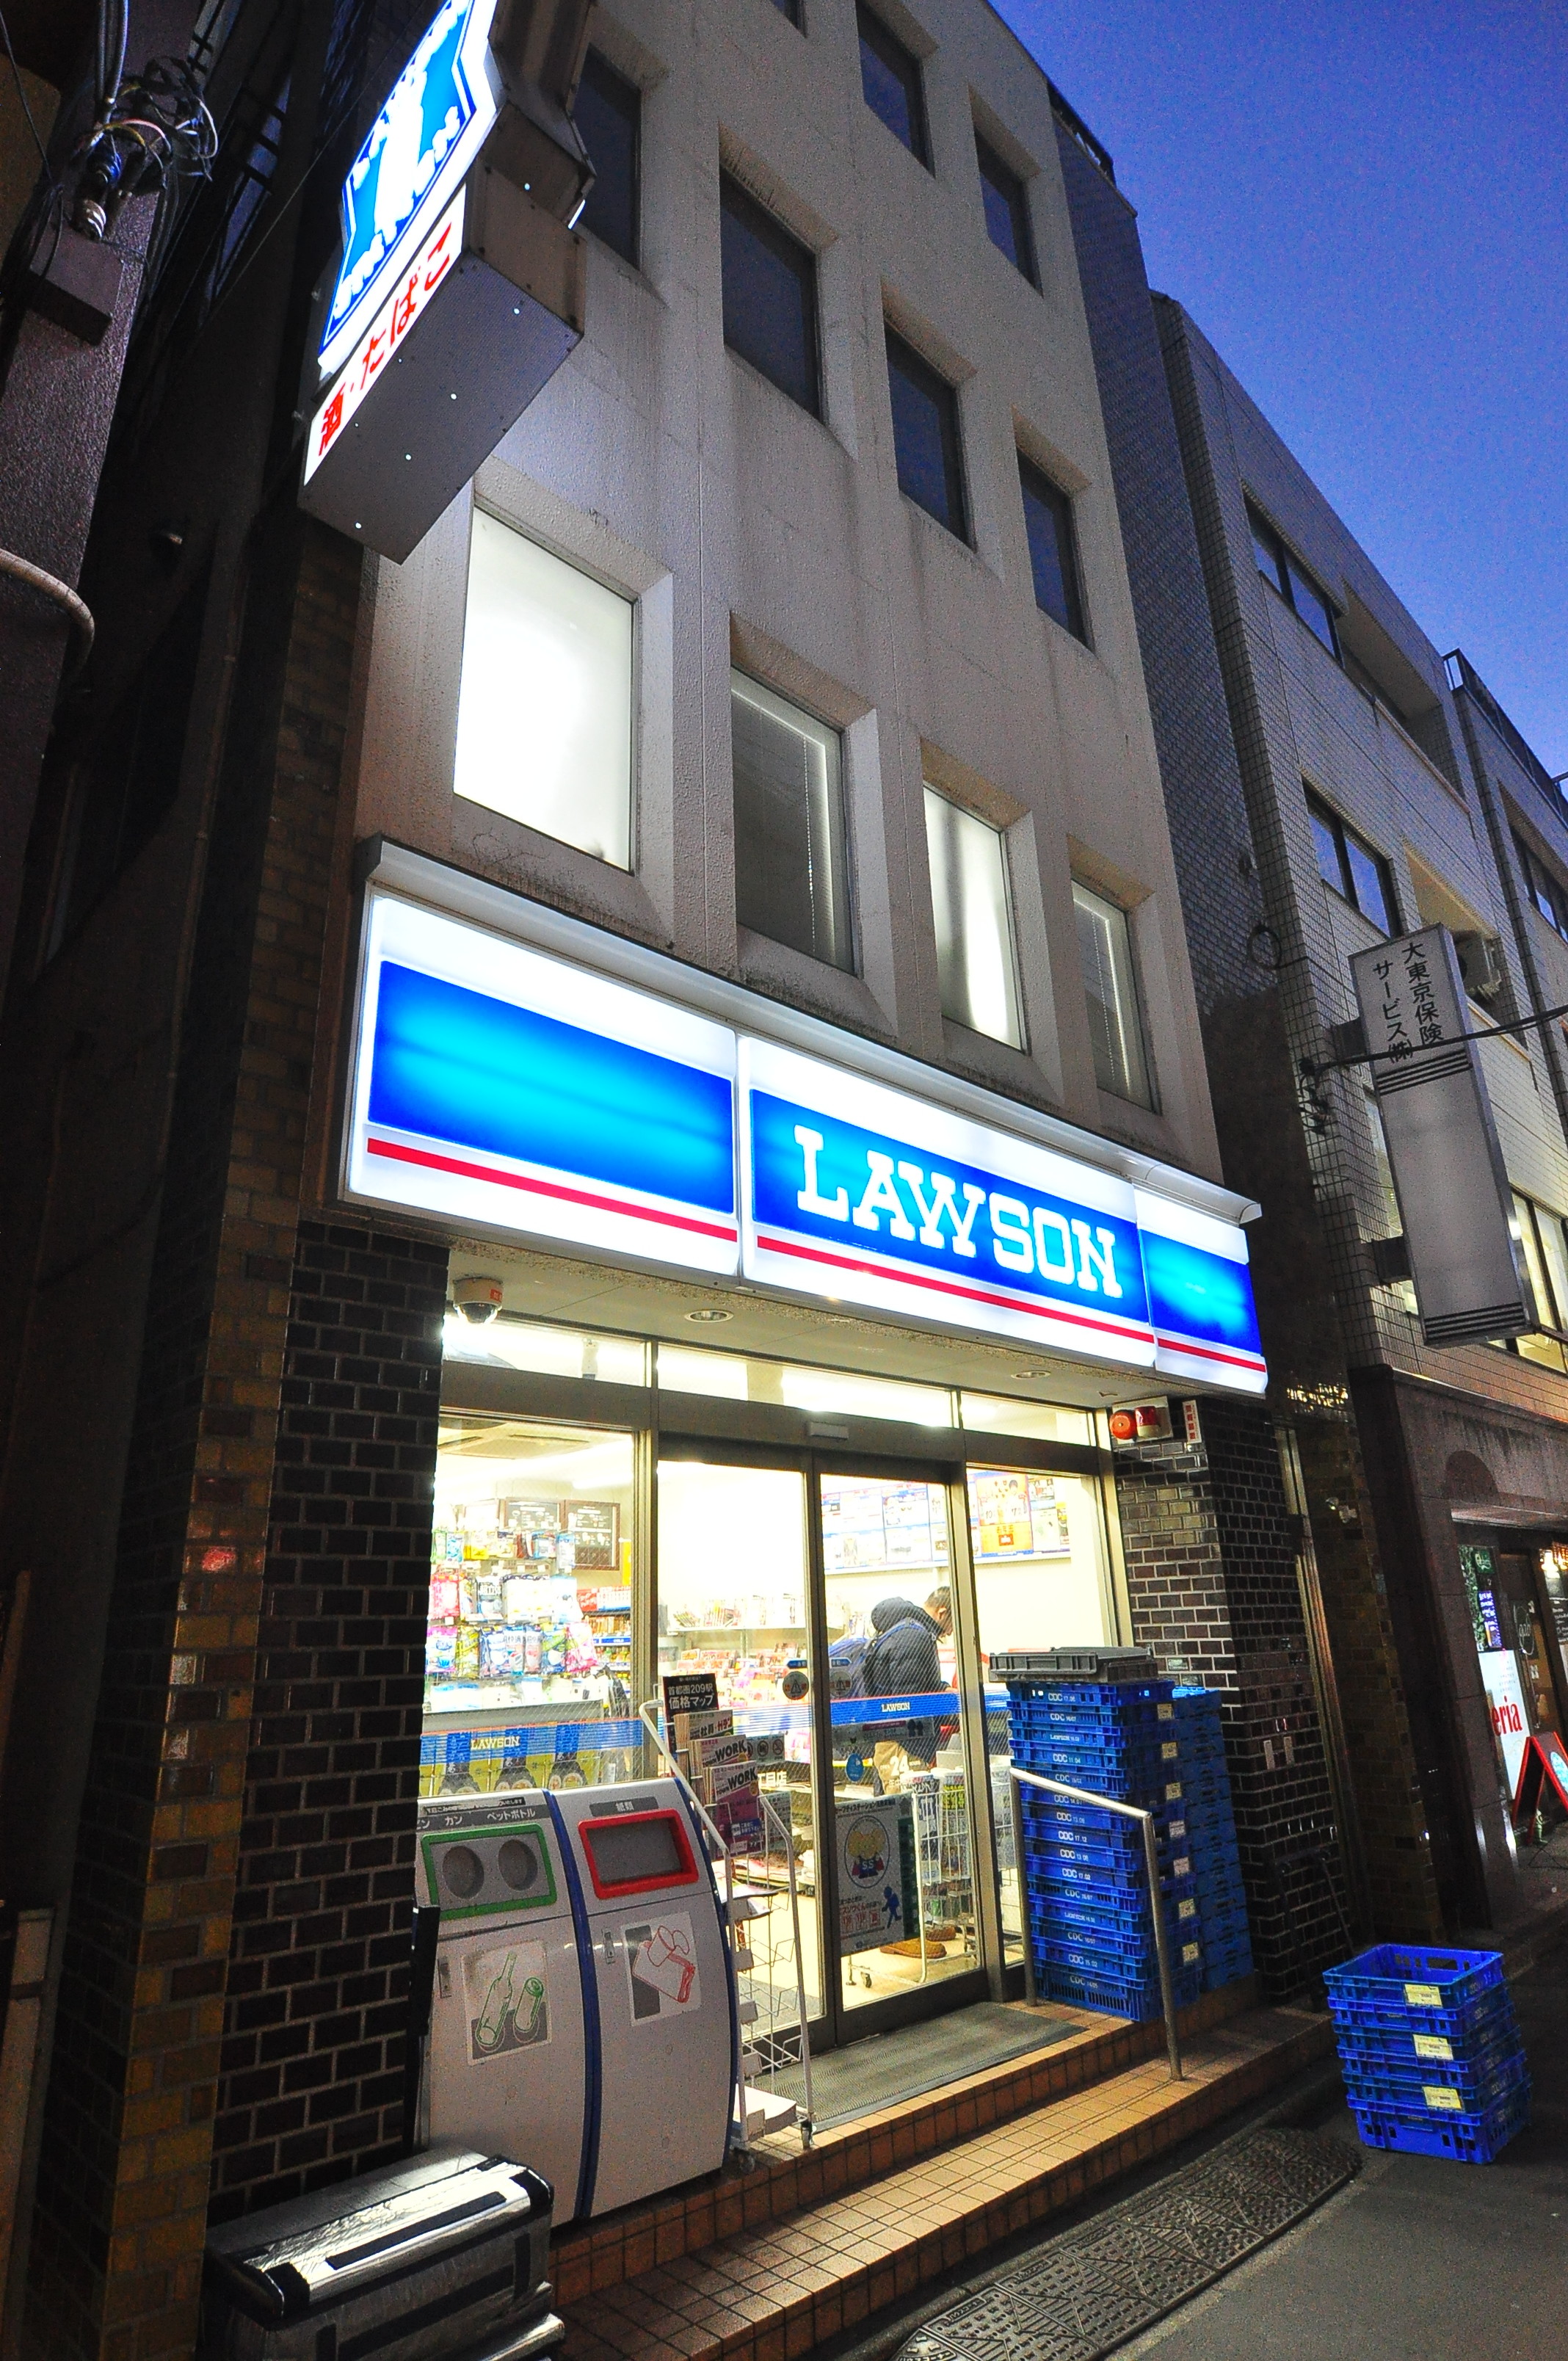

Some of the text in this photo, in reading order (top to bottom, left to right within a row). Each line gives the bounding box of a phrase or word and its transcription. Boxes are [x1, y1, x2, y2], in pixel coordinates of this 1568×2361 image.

[1402, 943, 1443, 1045] 大東京保険
[794, 1125, 1122, 1298] LAWSON
[668, 1683, 714, 1695] 首都圏209駅
[669, 1693, 714, 1710] 価格マップ
[1048, 1692, 1063, 1702] CDC
[882, 1702, 910, 1713] LAWSON
[1050, 1713, 1065, 1722] CDC
[471, 1736, 520, 1750] LAWSON
[715, 1739, 747, 1760] WORK
[1053, 1753, 1068, 1763] CDC
[889, 1755, 910, 1777] 24
[727, 1767, 758, 1790] WORK
[1055, 1774, 1070, 1782] CDC
[1054, 1794, 1070, 1804] CDC
[445, 1815, 463, 1826] カン
[487, 1807, 537, 1821] ペットボトル
[1056, 1811, 1072, 1822] CDC
[1058, 1830, 1074, 1841] CDC
[1059, 1849, 1075, 1860] CDC
[861, 1860, 874, 1871] SS
[1061, 1868, 1078, 1878] CDC
[1064, 1888, 1081, 1898] CDC
[1067, 1932, 1084, 1942] CDC
[1068, 1954, 1084, 1965] CDC
[1070, 1975, 1086, 1986] CDC
